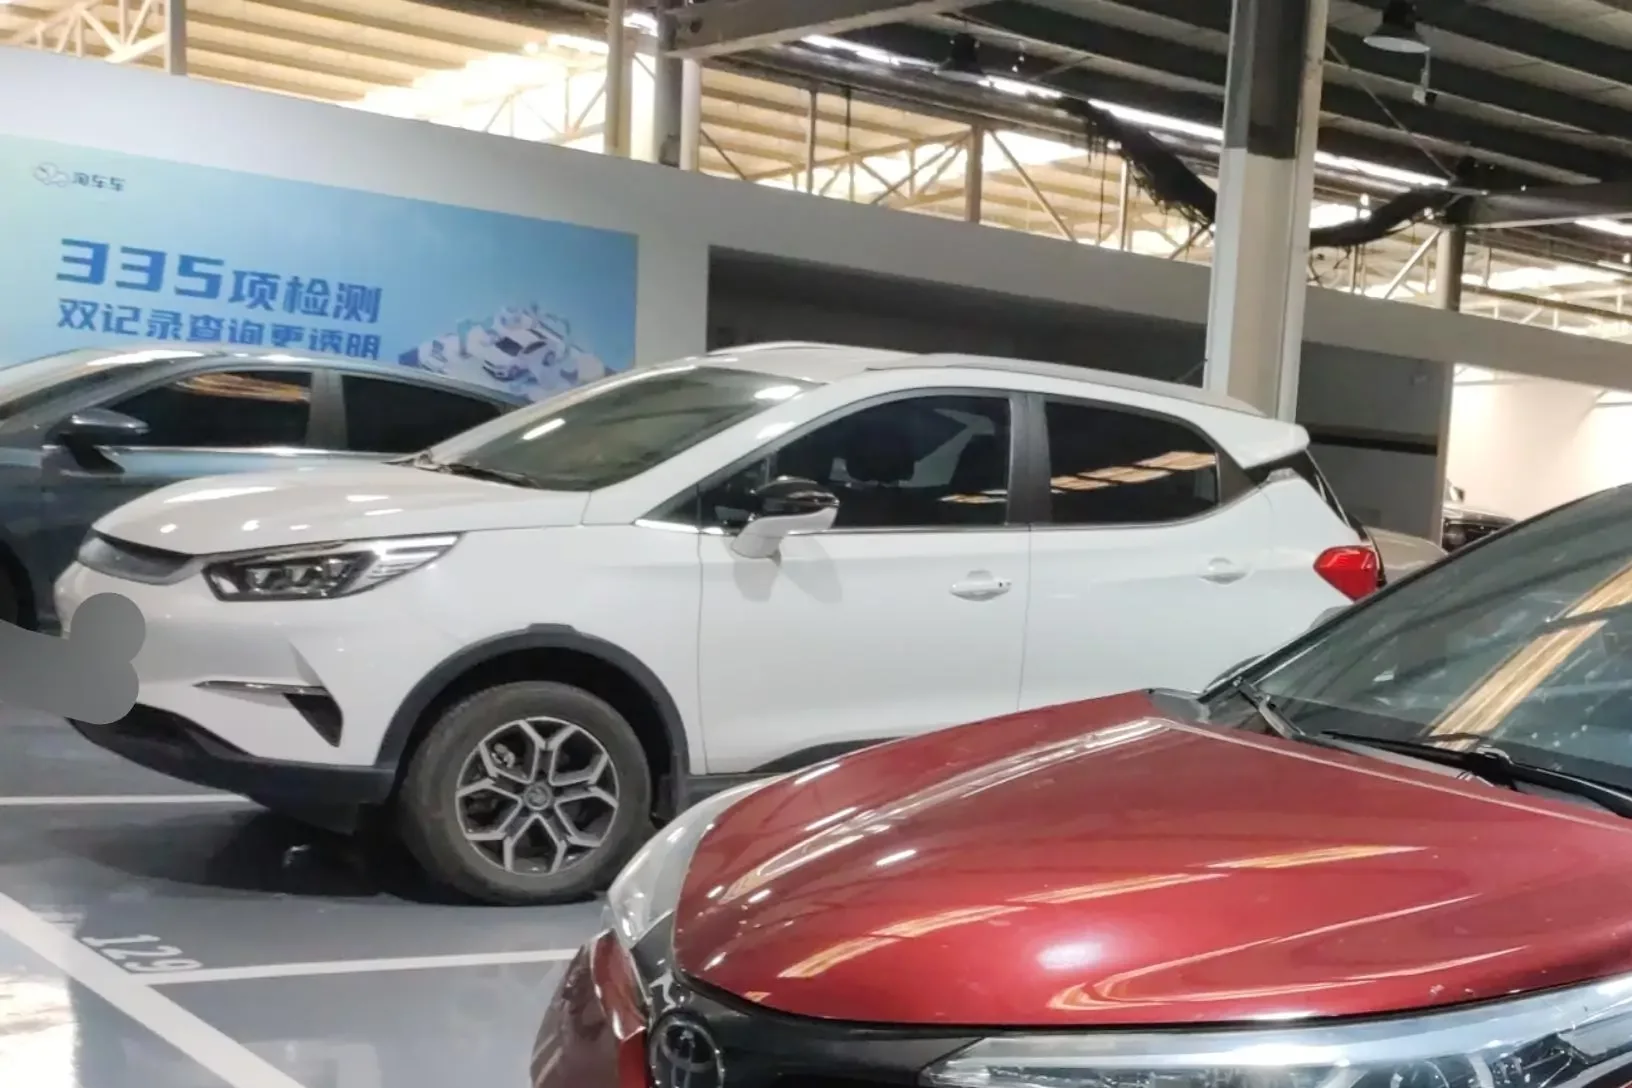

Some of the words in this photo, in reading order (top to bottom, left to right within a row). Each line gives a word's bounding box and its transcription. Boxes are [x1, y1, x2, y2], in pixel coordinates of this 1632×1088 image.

[56, 237, 383, 325] 335项检测
[57, 297, 382, 362] 双记录查询更透明
[80, 933, 204, 973] 129
